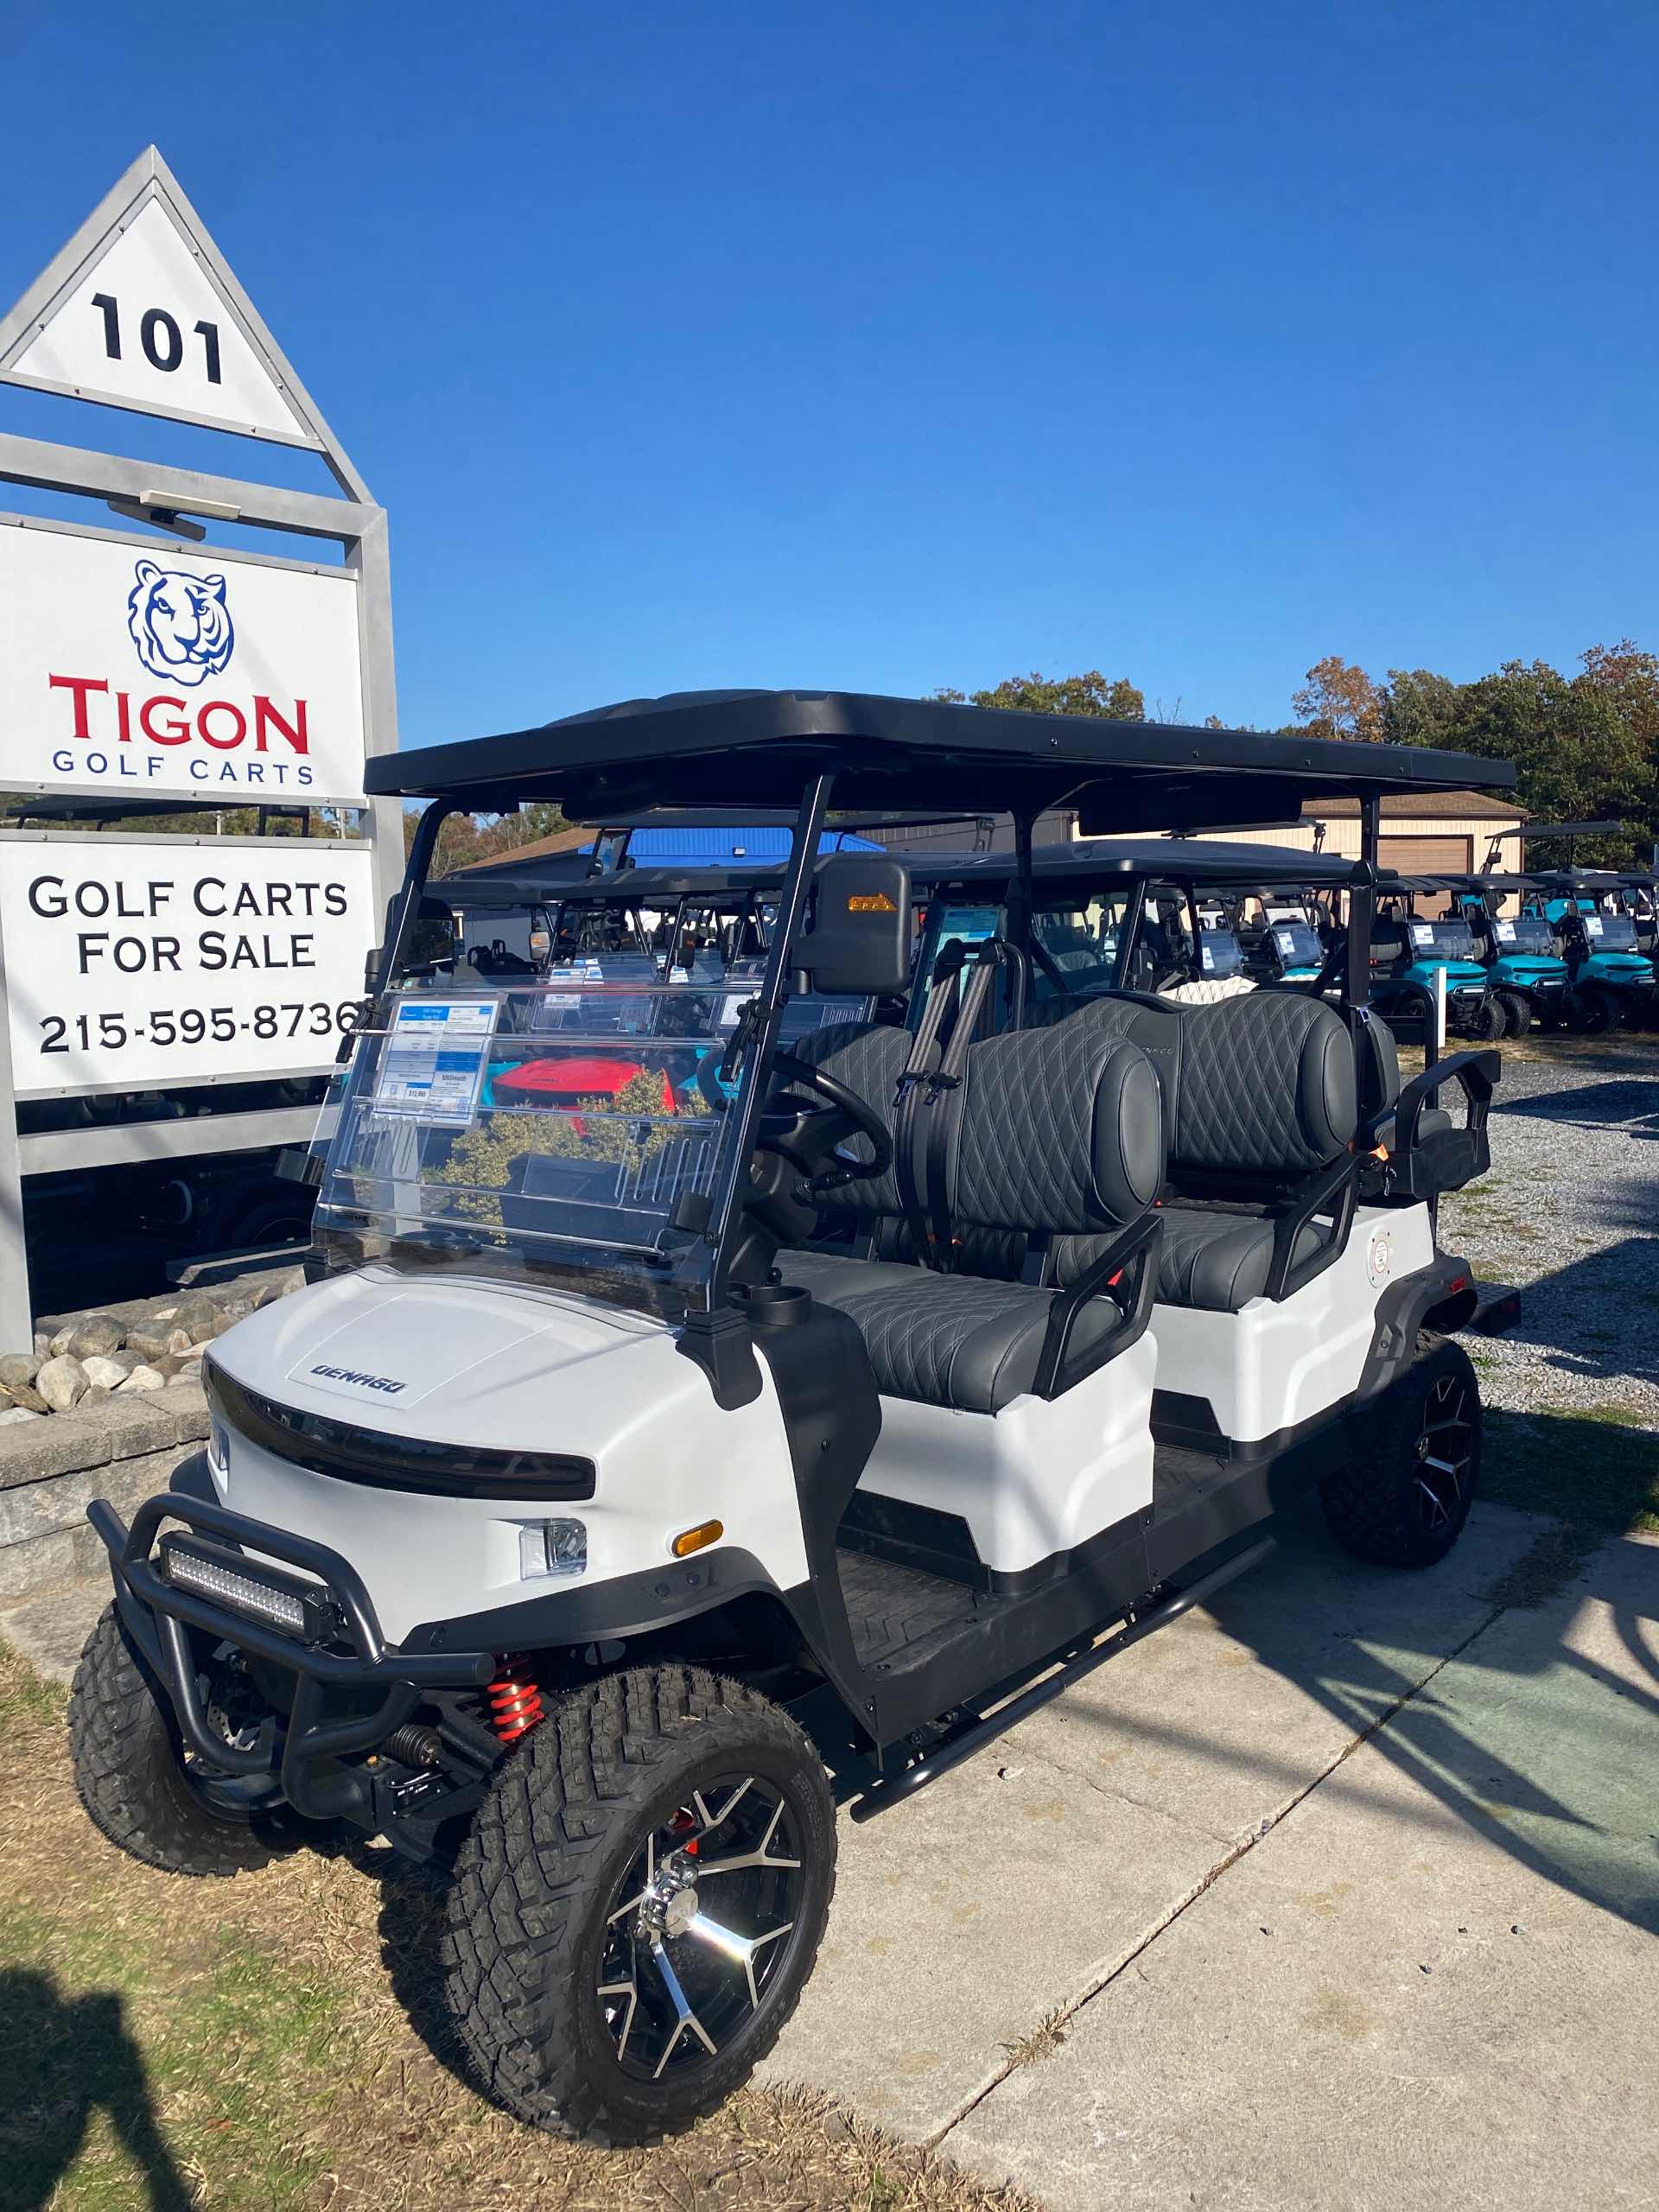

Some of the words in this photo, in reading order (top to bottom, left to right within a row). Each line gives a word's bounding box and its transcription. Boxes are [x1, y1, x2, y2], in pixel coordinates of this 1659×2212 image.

[91, 292, 222, 385] 101
[48, 672, 310, 755] TIGON
[53, 750, 164, 777] GOLF
[189, 759, 313, 785] CARTS
[28, 875, 175, 918] GOLF
[193, 877, 347, 917] CARTS
[77, 931, 183, 974] FOR
[198, 931, 316, 970] SALE
[38, 1001, 358, 1054] 215-595-8736
[310, 1364, 407, 1394] DENAGO
